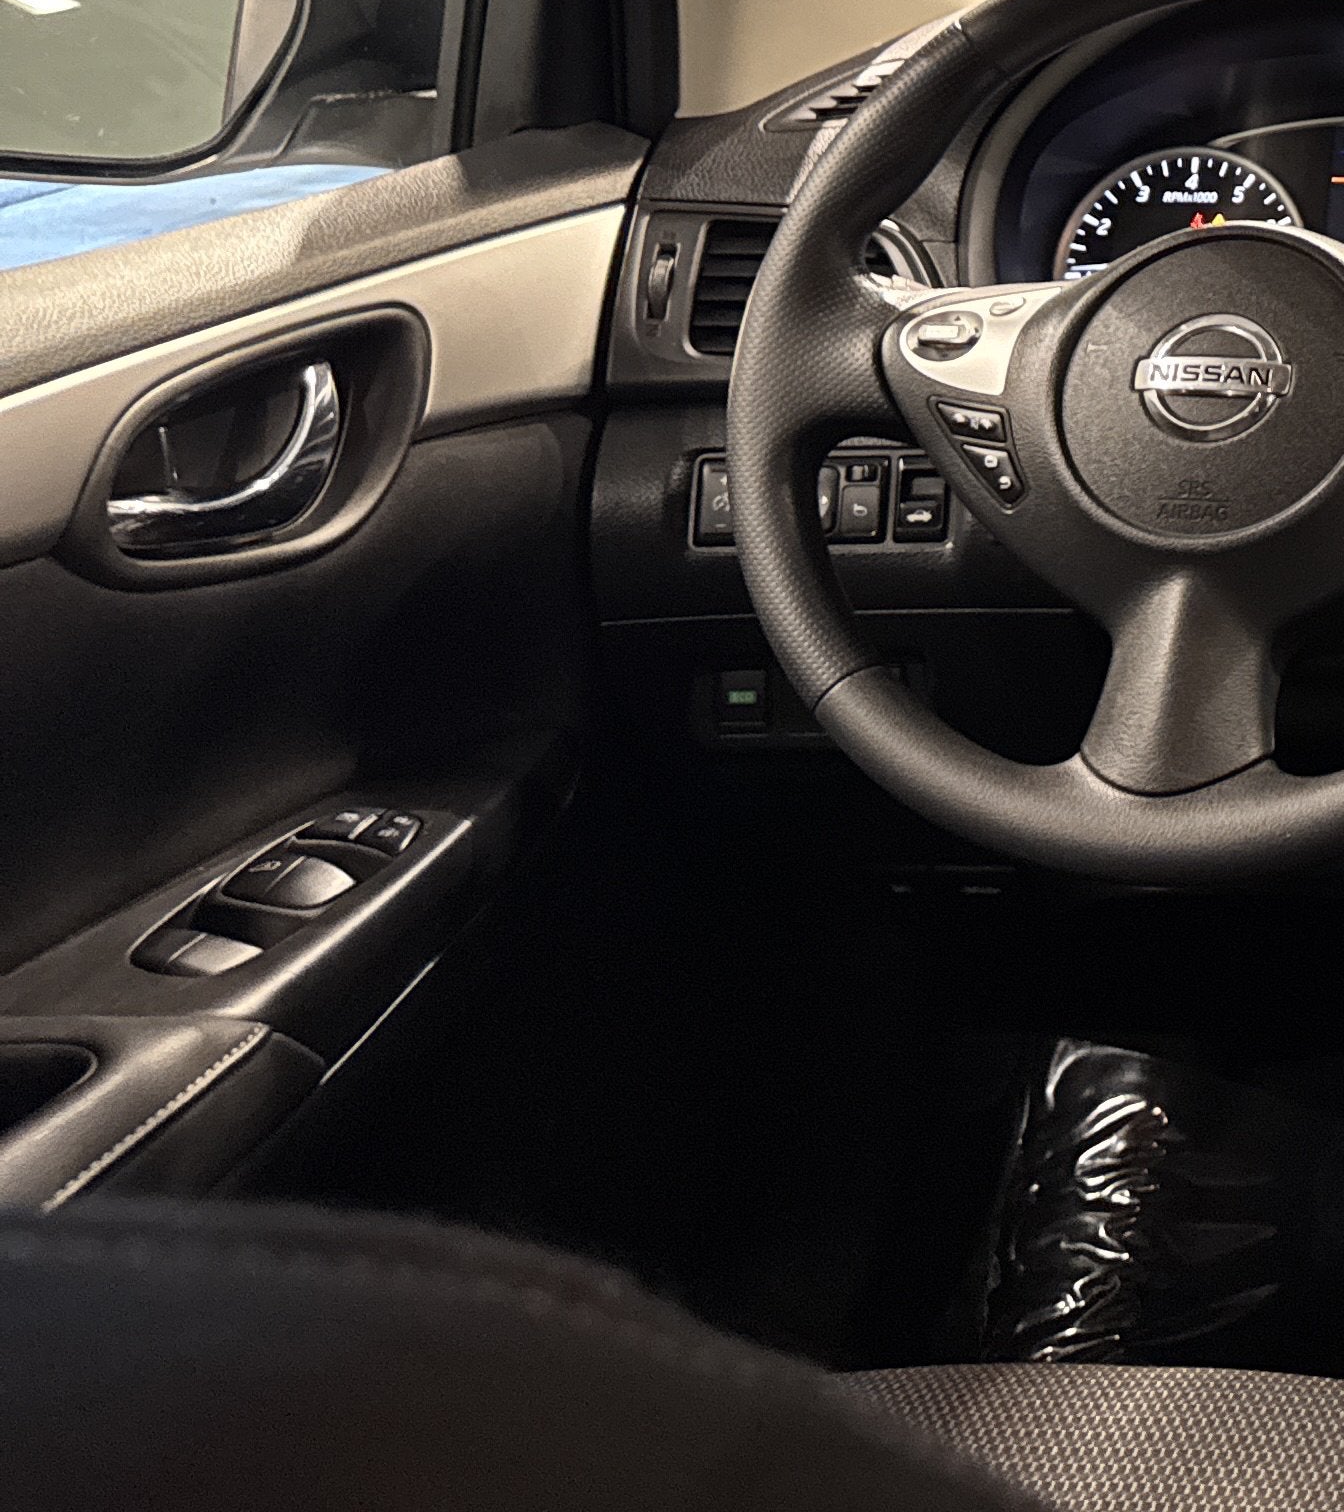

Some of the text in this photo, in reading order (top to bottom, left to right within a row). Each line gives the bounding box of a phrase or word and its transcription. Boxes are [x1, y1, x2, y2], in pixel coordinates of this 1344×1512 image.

[1184, 173, 1200, 190] 4
[1135, 185, 1150, 203] 3
[1232, 186, 1246, 204] 5
[1095, 217, 1112, 236] 2
[1149, 363, 1273, 387] NISSAN
[1156, 503, 1230, 521] AIRBAG
